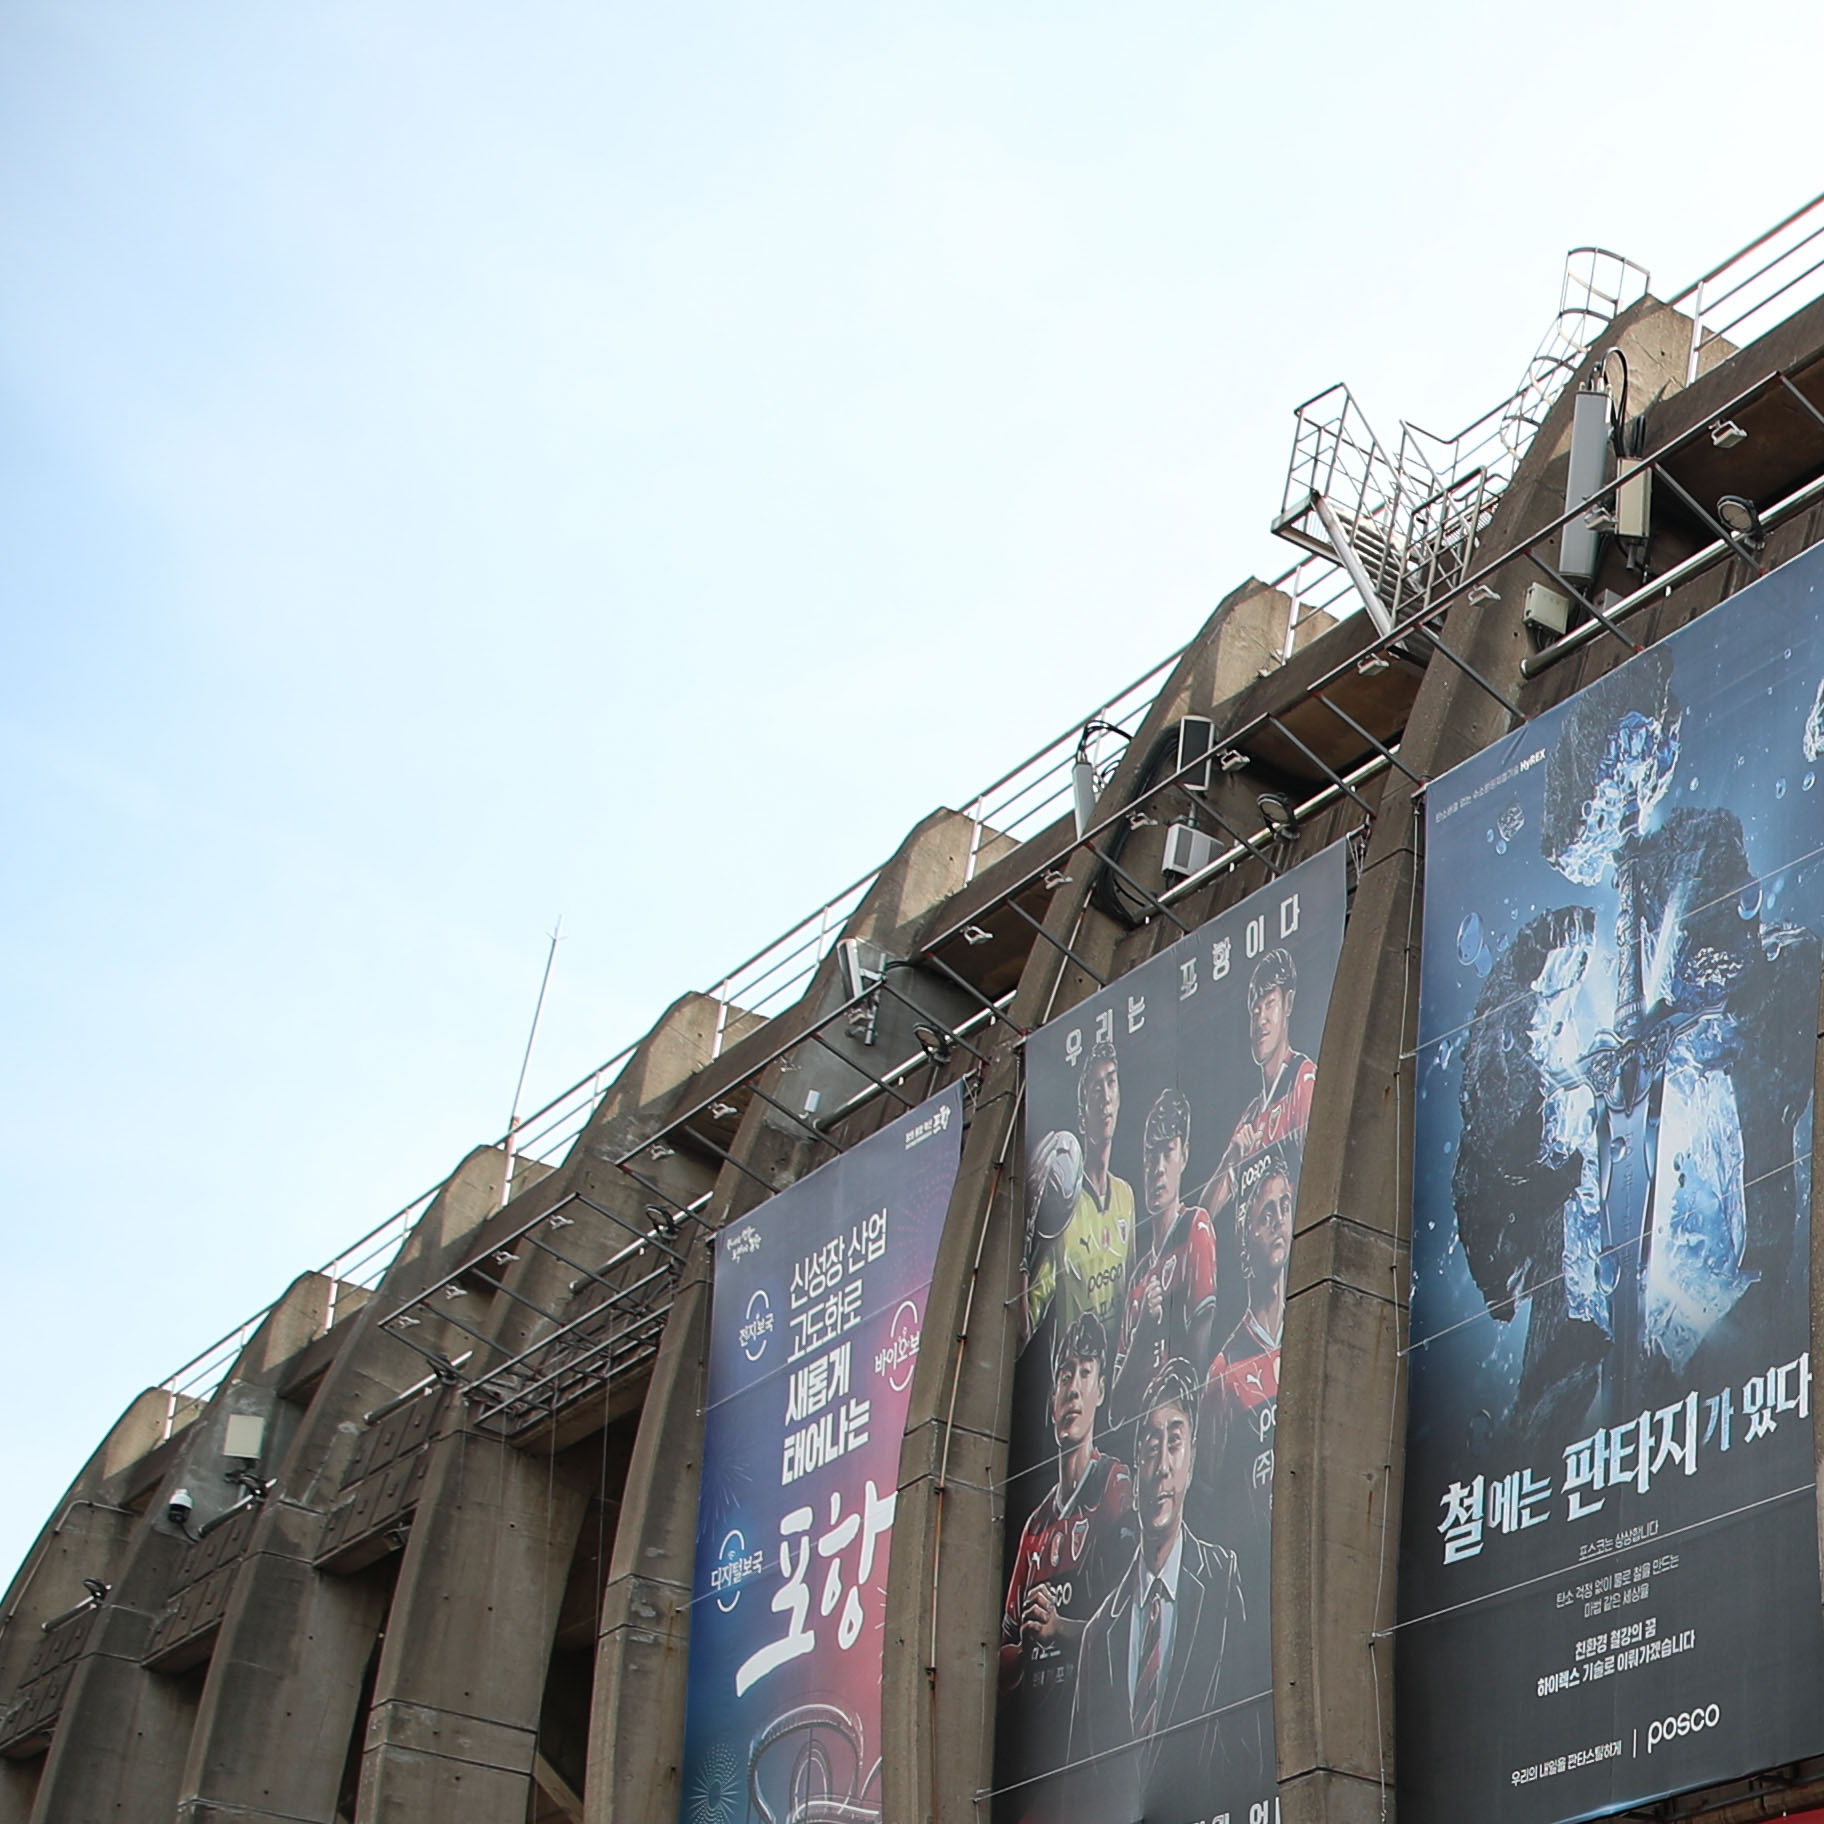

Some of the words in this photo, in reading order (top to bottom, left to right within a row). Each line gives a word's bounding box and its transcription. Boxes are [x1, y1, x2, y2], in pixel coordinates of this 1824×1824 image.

[1064, 992, 1147, 1067] 우리는
[1179, 894, 1302, 1000] 포항이다
[789, 1235, 845, 1310] 신성장
[848, 1207, 888, 1275] 산업
[787, 1279, 864, 1364] 고도화로
[874, 1330, 921, 1377] 바이오보
[784, 1342, 853, 1427] 새롭게
[781, 1397, 871, 1487] 태어나는
[1437, 1469, 1553, 1565] 철에는
[1560, 1386, 1736, 1522] 판타지가
[1743, 1352, 1813, 1445] 있다
[710, 1550, 765, 1592] 디지털보국
[1578, 1536, 1615, 1562] 포스코는
[1575, 1634, 1608, 1662] 친환경
[1609, 1624, 1643, 1650] 철강의
[1537, 1671, 1581, 1697] 하이렉스
[1582, 1658, 1616, 1683] 기술로
[1647, 1703, 1721, 1754] posco
[1511, 1764, 1538, 1787] 우리의
